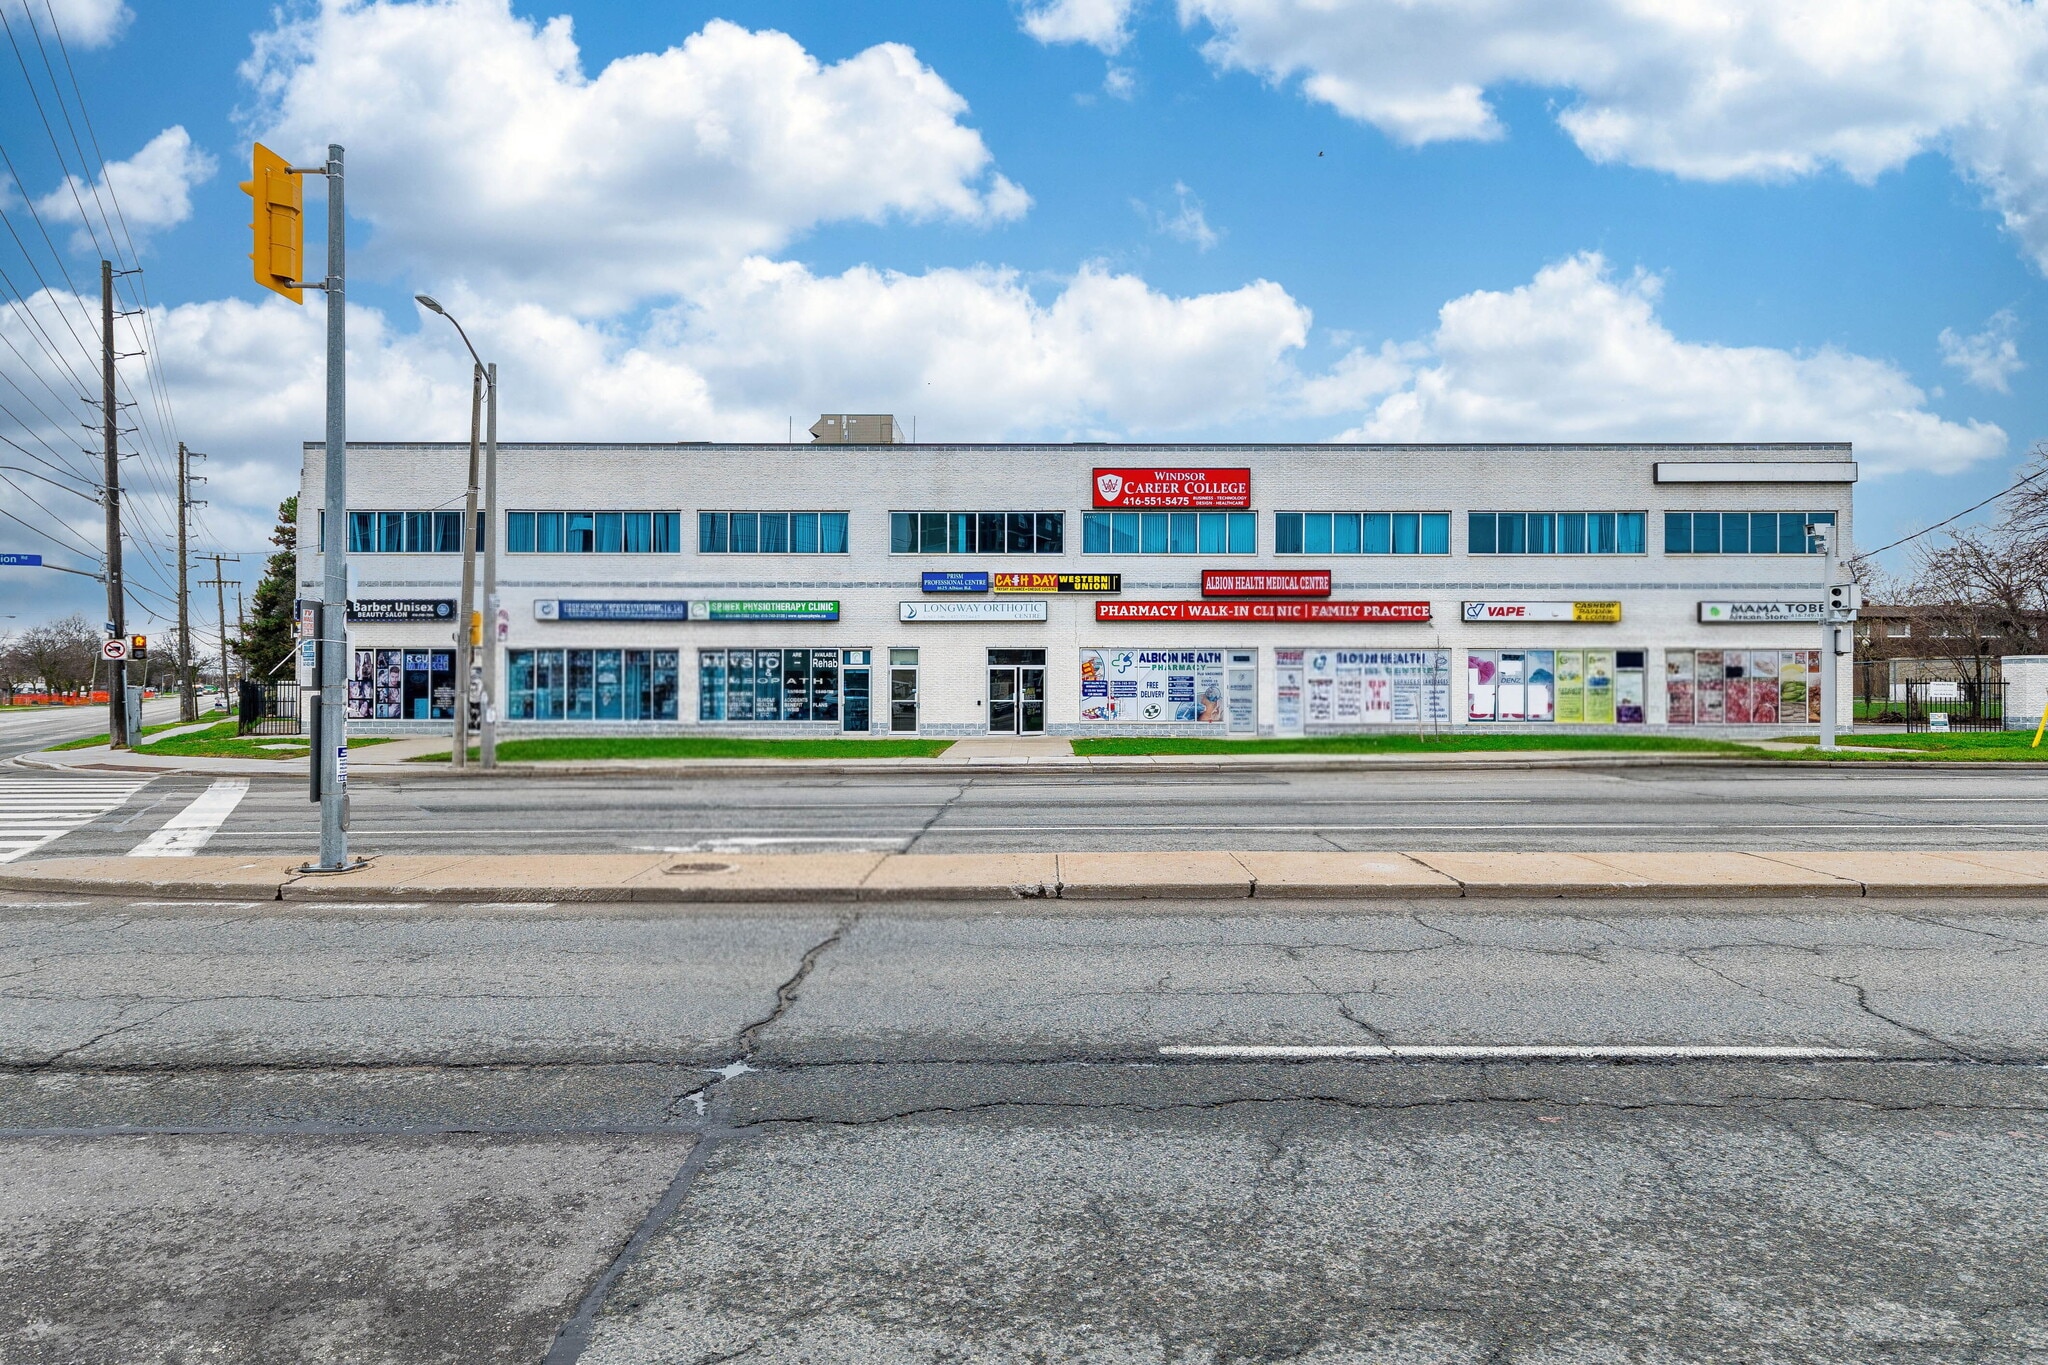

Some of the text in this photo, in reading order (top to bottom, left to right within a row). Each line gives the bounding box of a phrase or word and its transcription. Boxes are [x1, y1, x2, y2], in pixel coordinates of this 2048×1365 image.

[1154, 472, 1205, 481] WINDSOR
[1124, 482, 1246, 494] CAREER COLLEGE
[1123, 497, 1189, 505] 416-551-5475
[1033, 574, 1057, 586] DAY
[1059, 575, 1107, 583] WESTERN
[1206, 577, 1328, 589] ALBION HEALTH MEDICAL CENTRE
[353, 602, 434, 612] Barber Unisex
[743, 602, 805, 611] PHYSIOTHERAPY
[808, 602, 834, 611] CLINIC
[924, 604, 1041, 612] LONGWAY ORTHOTIC
[1100, 605, 1429, 617] PHARMACY WALK-IN CLINIC FAMILY PRACTICE
[1488, 606, 1525, 616] VAPE
[1731, 604, 1780, 613] MAMA
[1765, 612, 1789, 620] Store
[812, 658, 838, 668] Rehab
[1139, 653, 1221, 663] ALBION HEALTH
